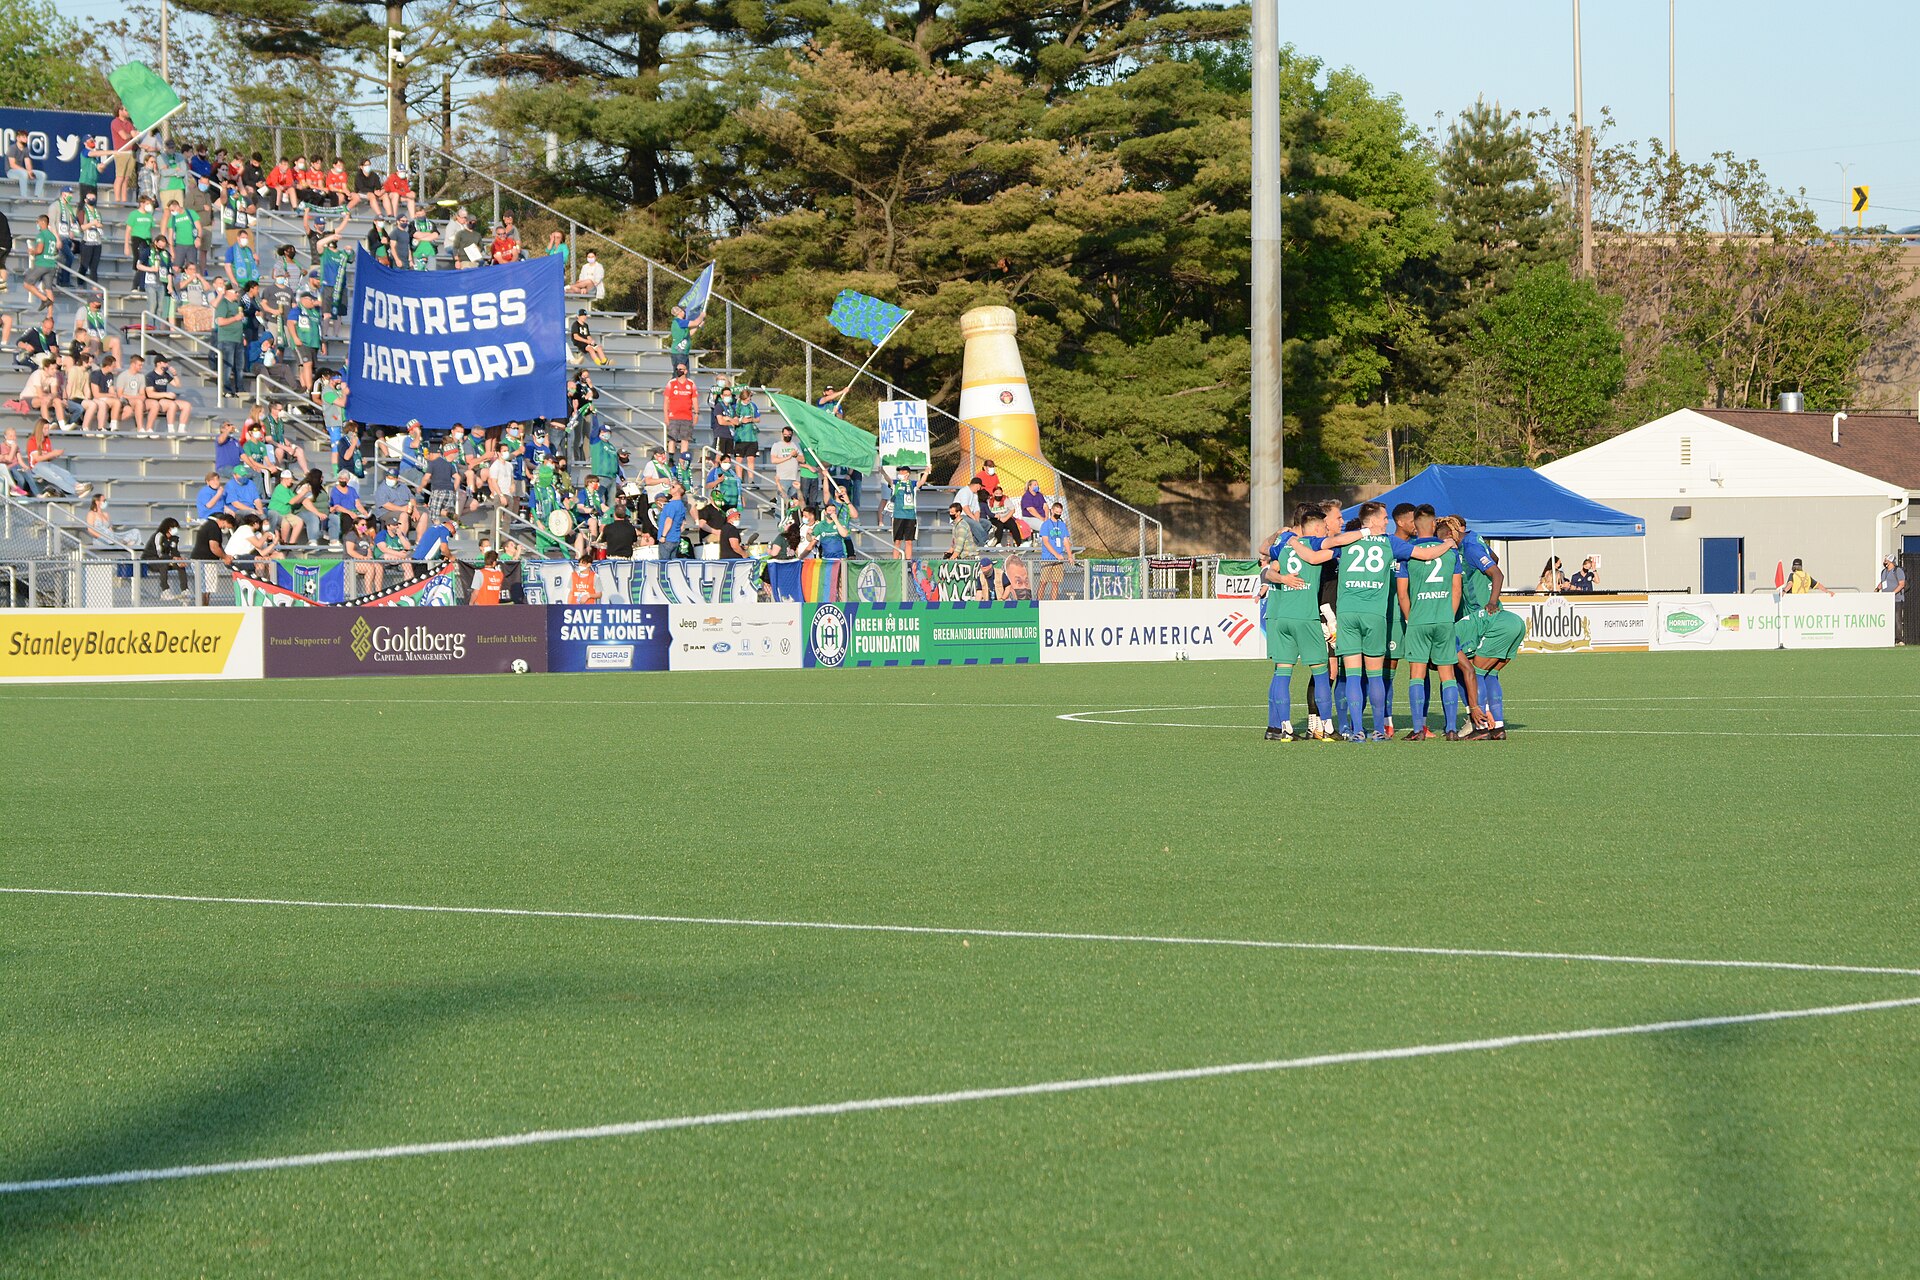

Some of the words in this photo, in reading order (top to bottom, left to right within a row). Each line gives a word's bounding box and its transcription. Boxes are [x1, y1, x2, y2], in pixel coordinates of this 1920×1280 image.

[362, 286, 527, 335] FORTRESS
[361, 341, 536, 387] HARTFORD
[894, 402, 916, 416] IN
[880, 417, 927, 432] WATLING
[881, 430, 894, 443] WE
[898, 429, 927, 443] TRUST
[1287, 549, 1302, 574] 6
[1347, 545, 1385, 572] 28
[938, 562, 971, 583] MAD
[1424, 557, 1444, 583] 2
[1092, 575, 1132, 600] DEAD
[1345, 580, 1384, 589] STANLEY
[1417, 591, 1450, 600] STANLEY
[563, 609, 602, 624] SAVE
[606, 609, 642, 624] TIME
[679, 618, 697, 629] Jeep
[813, 606, 846, 626] HARTFORD
[1531, 604, 1582, 638] Modelo
[1604, 620, 1628, 628] FIGHTING
[1629, 619, 1644, 628] SPIRIT
[1668, 619, 1699, 627] HORNITOS
[1758, 615, 1790, 630] SHOT
[1793, 614, 1840, 629] WORTH
[1843, 614, 1886, 629] TAKING
[855, 618, 883, 632] GREEN
[898, 617, 920, 631] BLUE
[476, 634, 507, 644] Hartford
[510, 634, 538, 643] Athletic
[560, 626, 599, 640] SAVE
[603, 625, 655, 640] MONEY
[933, 626, 1038, 641] GREENANDBLUEFOUNDATION.ORG
[1044, 628, 1094, 648] BANK
[1101, 627, 1124, 646] OF
[1129, 626, 1213, 646] AMERICA
[270, 636, 292, 646] Proud
[294, 636, 330, 647] Supporter
[332, 635, 342, 645] of
[372, 625, 466, 659] Goldberg
[855, 635, 920, 654] FOUNDATION
[814, 647, 846, 665] ATHLETIC
